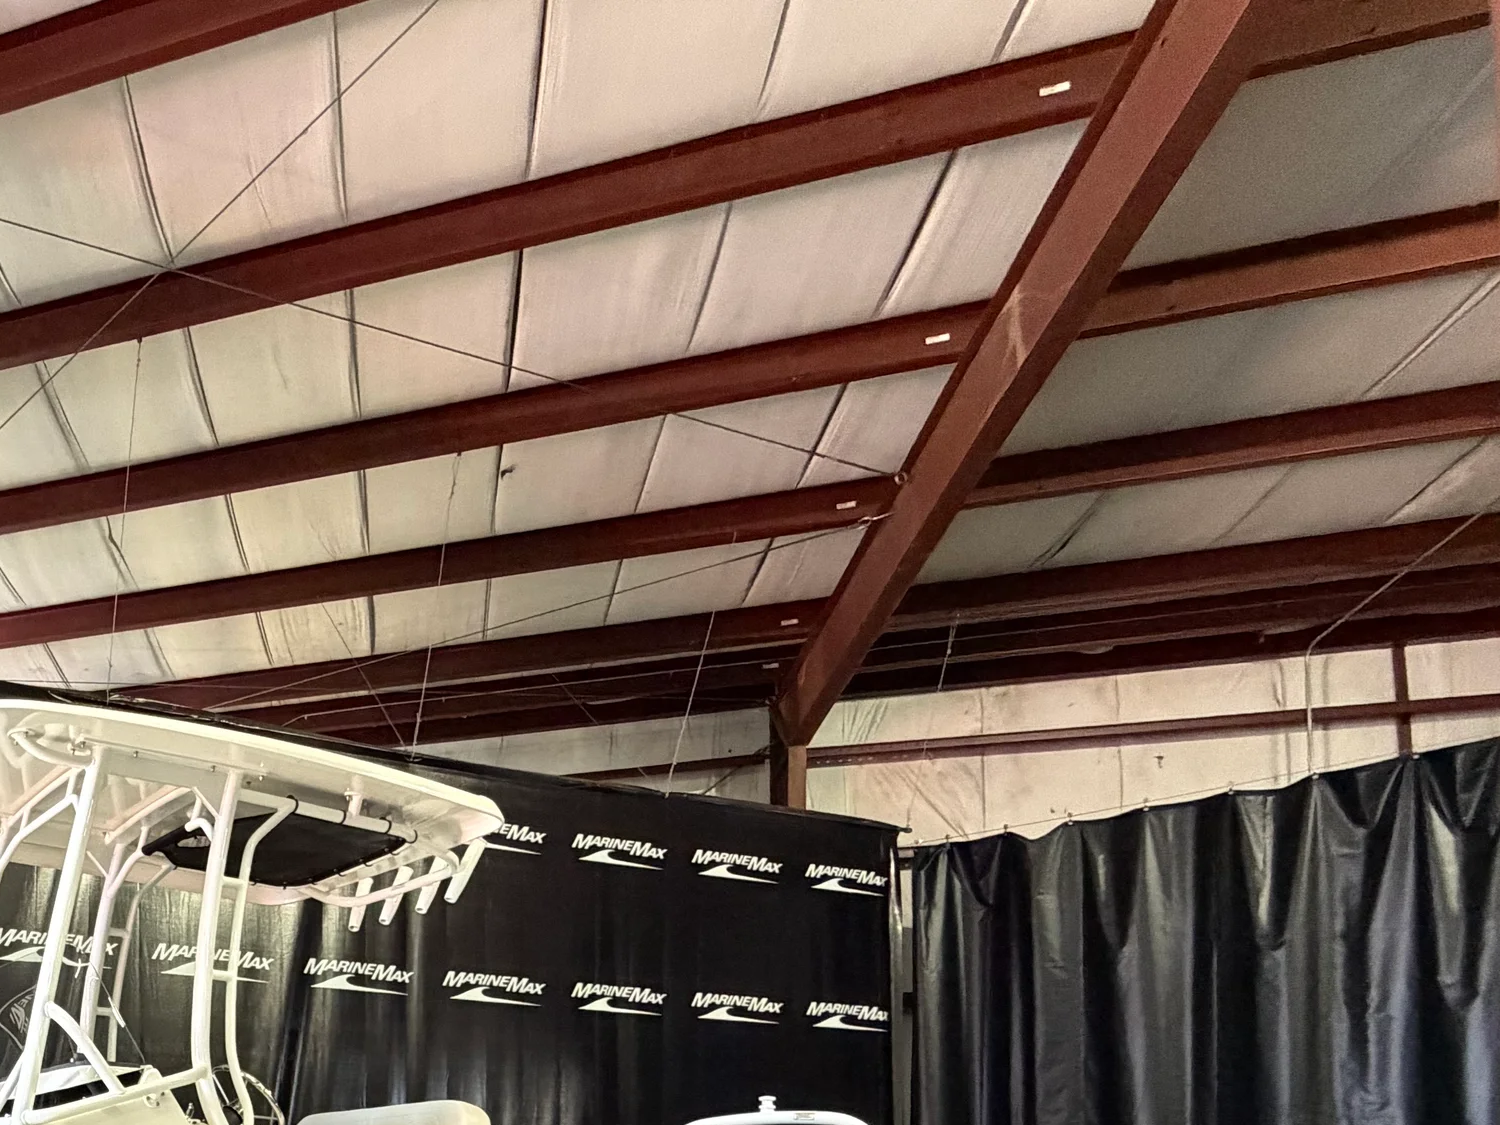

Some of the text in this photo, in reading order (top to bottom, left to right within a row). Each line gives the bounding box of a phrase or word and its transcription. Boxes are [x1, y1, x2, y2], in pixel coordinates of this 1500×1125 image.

[571, 833, 668, 859] MARINEMAX
[691, 849, 783, 874] MARINEMAX
[303, 957, 415, 984] MARINEMAX
[442, 970, 546, 995] MARINEMAX
[571, 982, 667, 1005] MARINEMAX
[691, 992, 784, 1013] MARINEMAX
